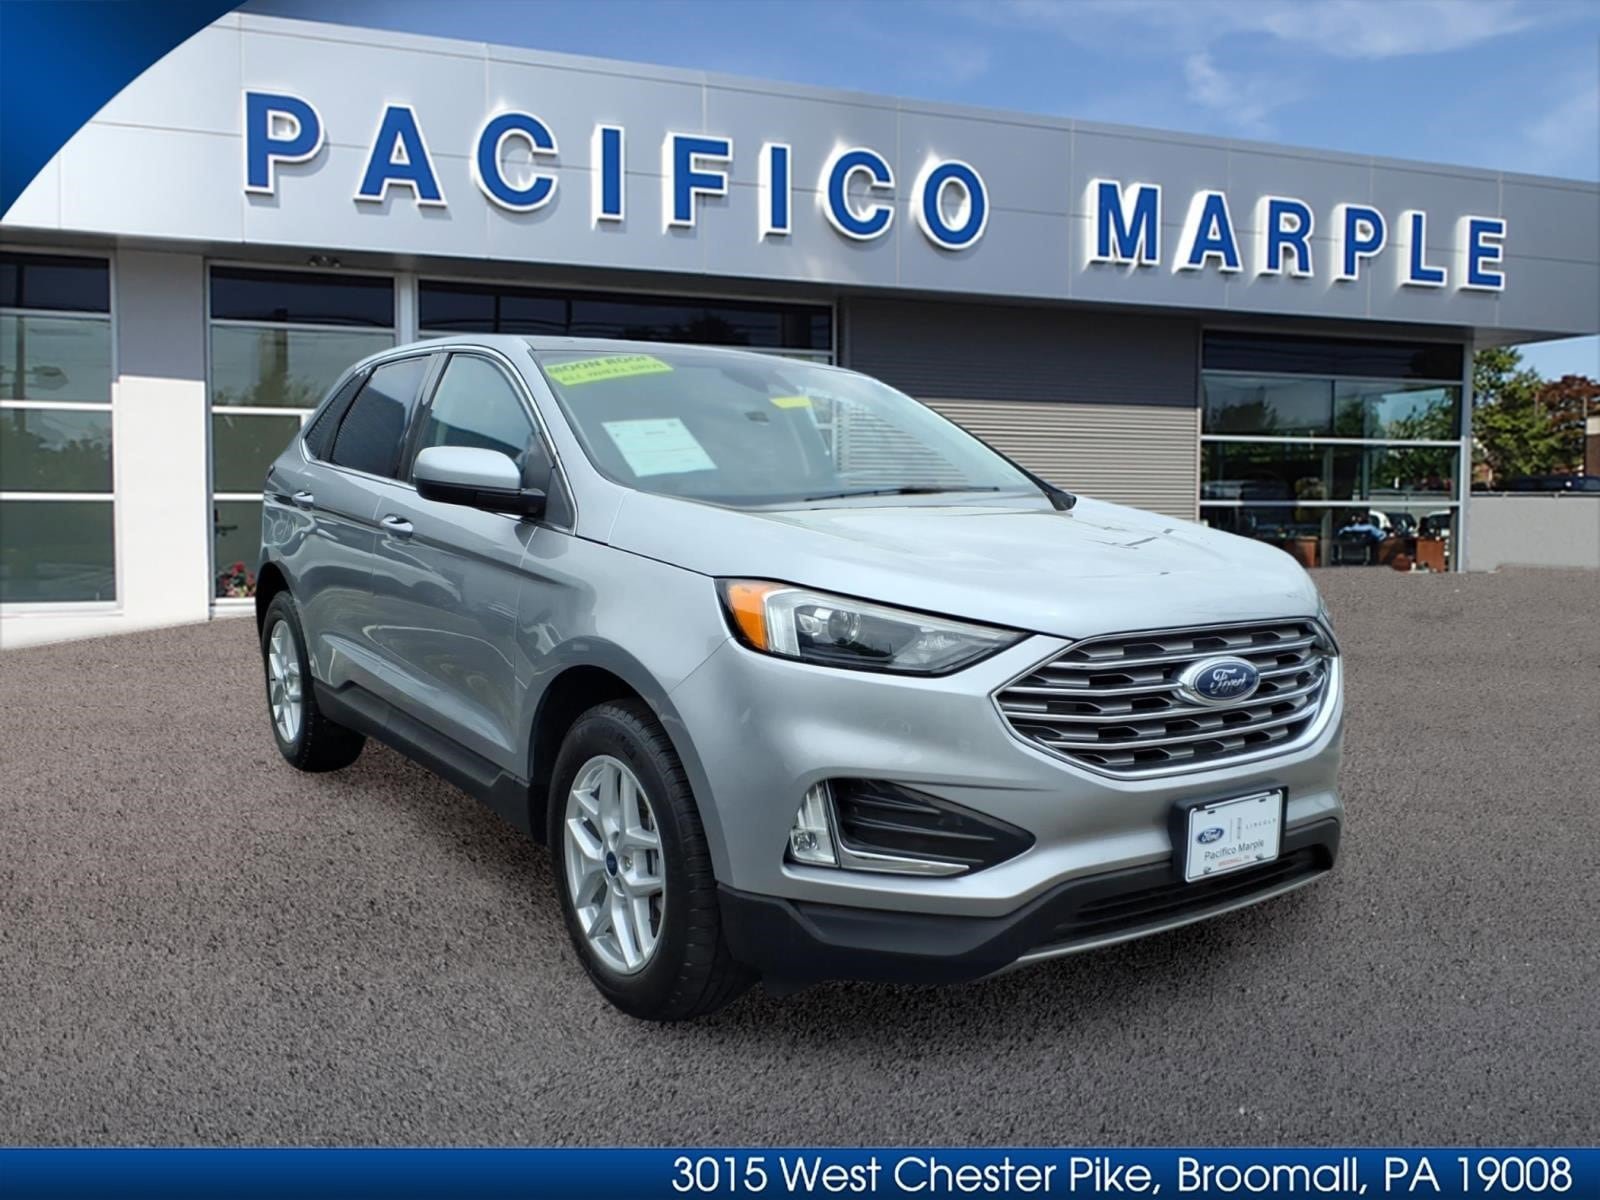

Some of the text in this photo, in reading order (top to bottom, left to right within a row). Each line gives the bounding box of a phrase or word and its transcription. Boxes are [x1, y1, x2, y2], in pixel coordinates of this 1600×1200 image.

[242, 88, 1508, 291] PACIFICO MARPLE
[1204, 839, 1264, 860] Pacifico Marple
